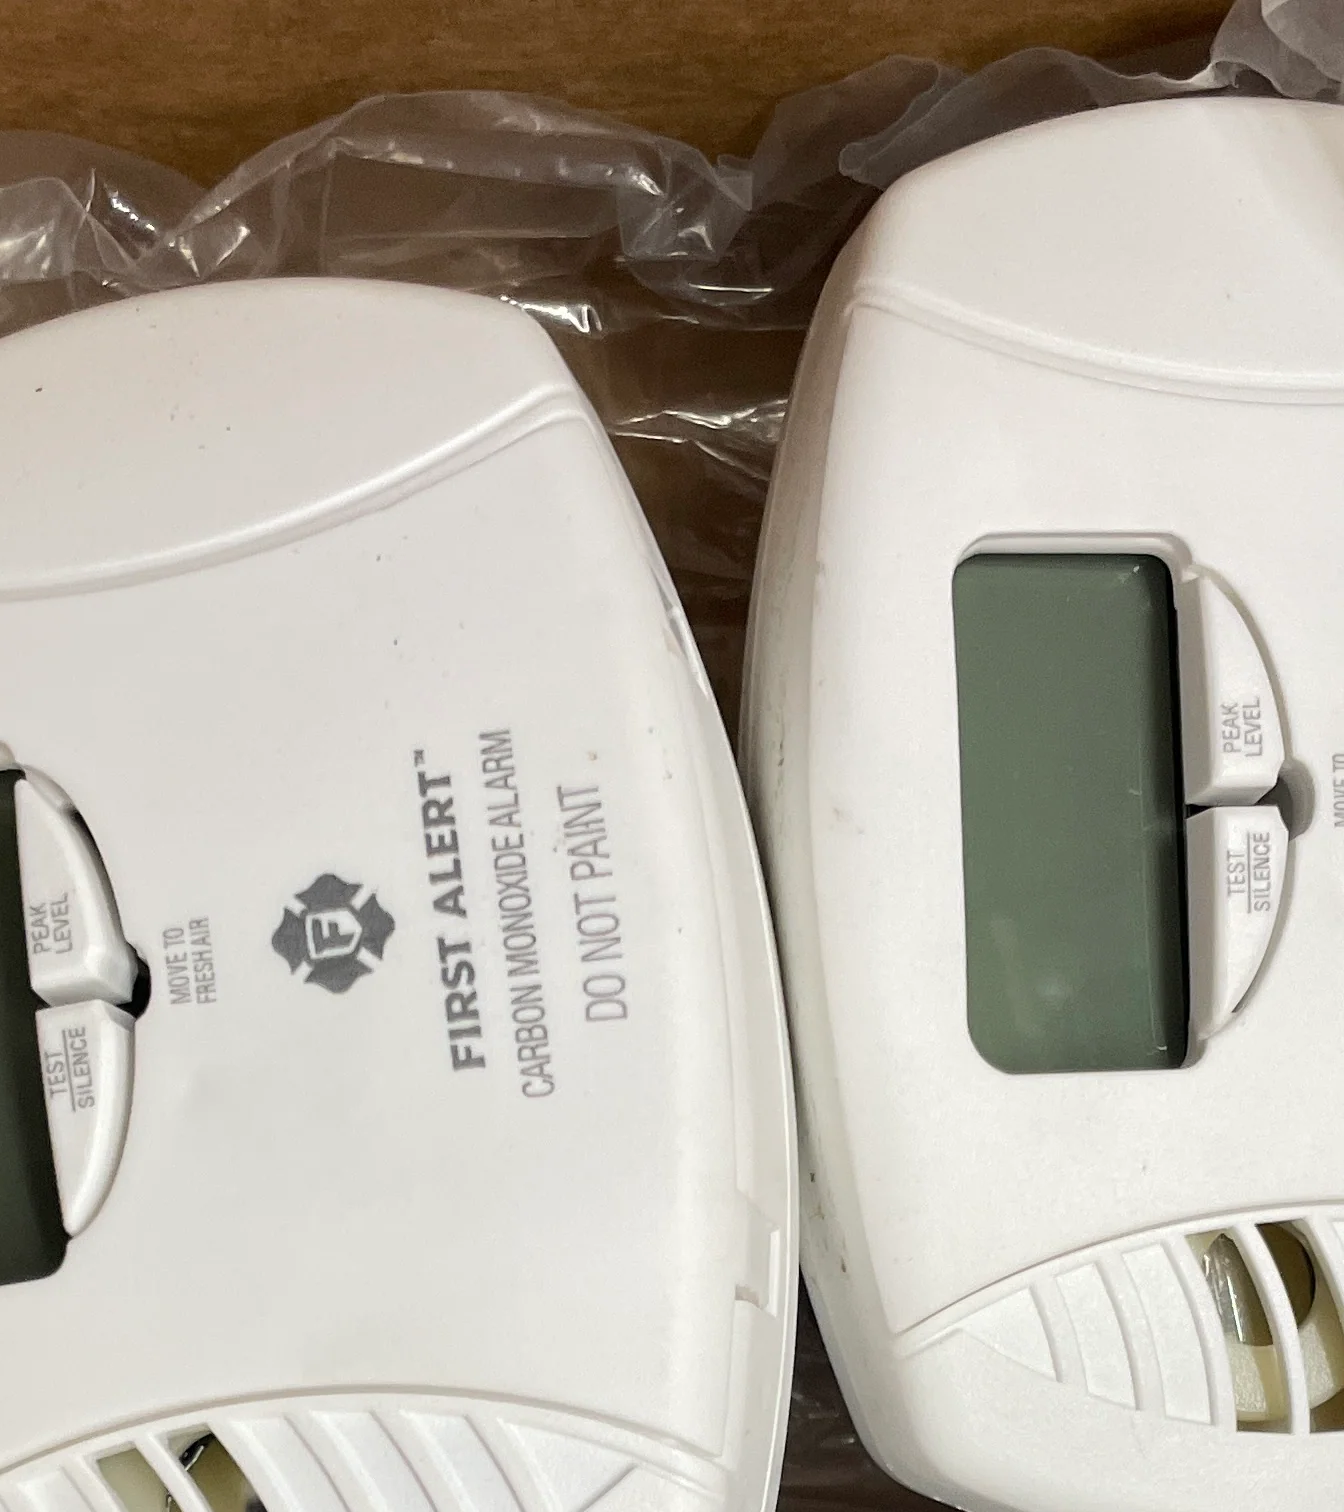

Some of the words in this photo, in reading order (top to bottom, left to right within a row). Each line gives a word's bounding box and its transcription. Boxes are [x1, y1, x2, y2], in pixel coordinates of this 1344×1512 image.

[1221, 703, 1241, 753] PEAK
[1241, 697, 1262, 757] LEVEL
[479, 728, 523, 830] ALARM
[557, 784, 612, 879] PAINT
[1227, 850, 1246, 896] TEST
[1252, 831, 1272, 912] SILENCE
[30, 902, 51, 955] PEAK
[50, 892, 72, 955] LEVEL
[189, 917, 210, 948] AIR
[489, 834, 541, 977] MONOXIDE
[573, 892, 623, 960] NOT
[163, 927, 185, 950] TO
[166, 952, 192, 1006] MOVE
[193, 949, 217, 1005] FRESH
[436, 936, 486, 1072] FIRST
[583, 974, 628, 1022] DO
[67, 1026, 95, 1109] SILENCE
[509, 984, 555, 1098] CARBON
[45, 1050, 66, 1098] TEST
